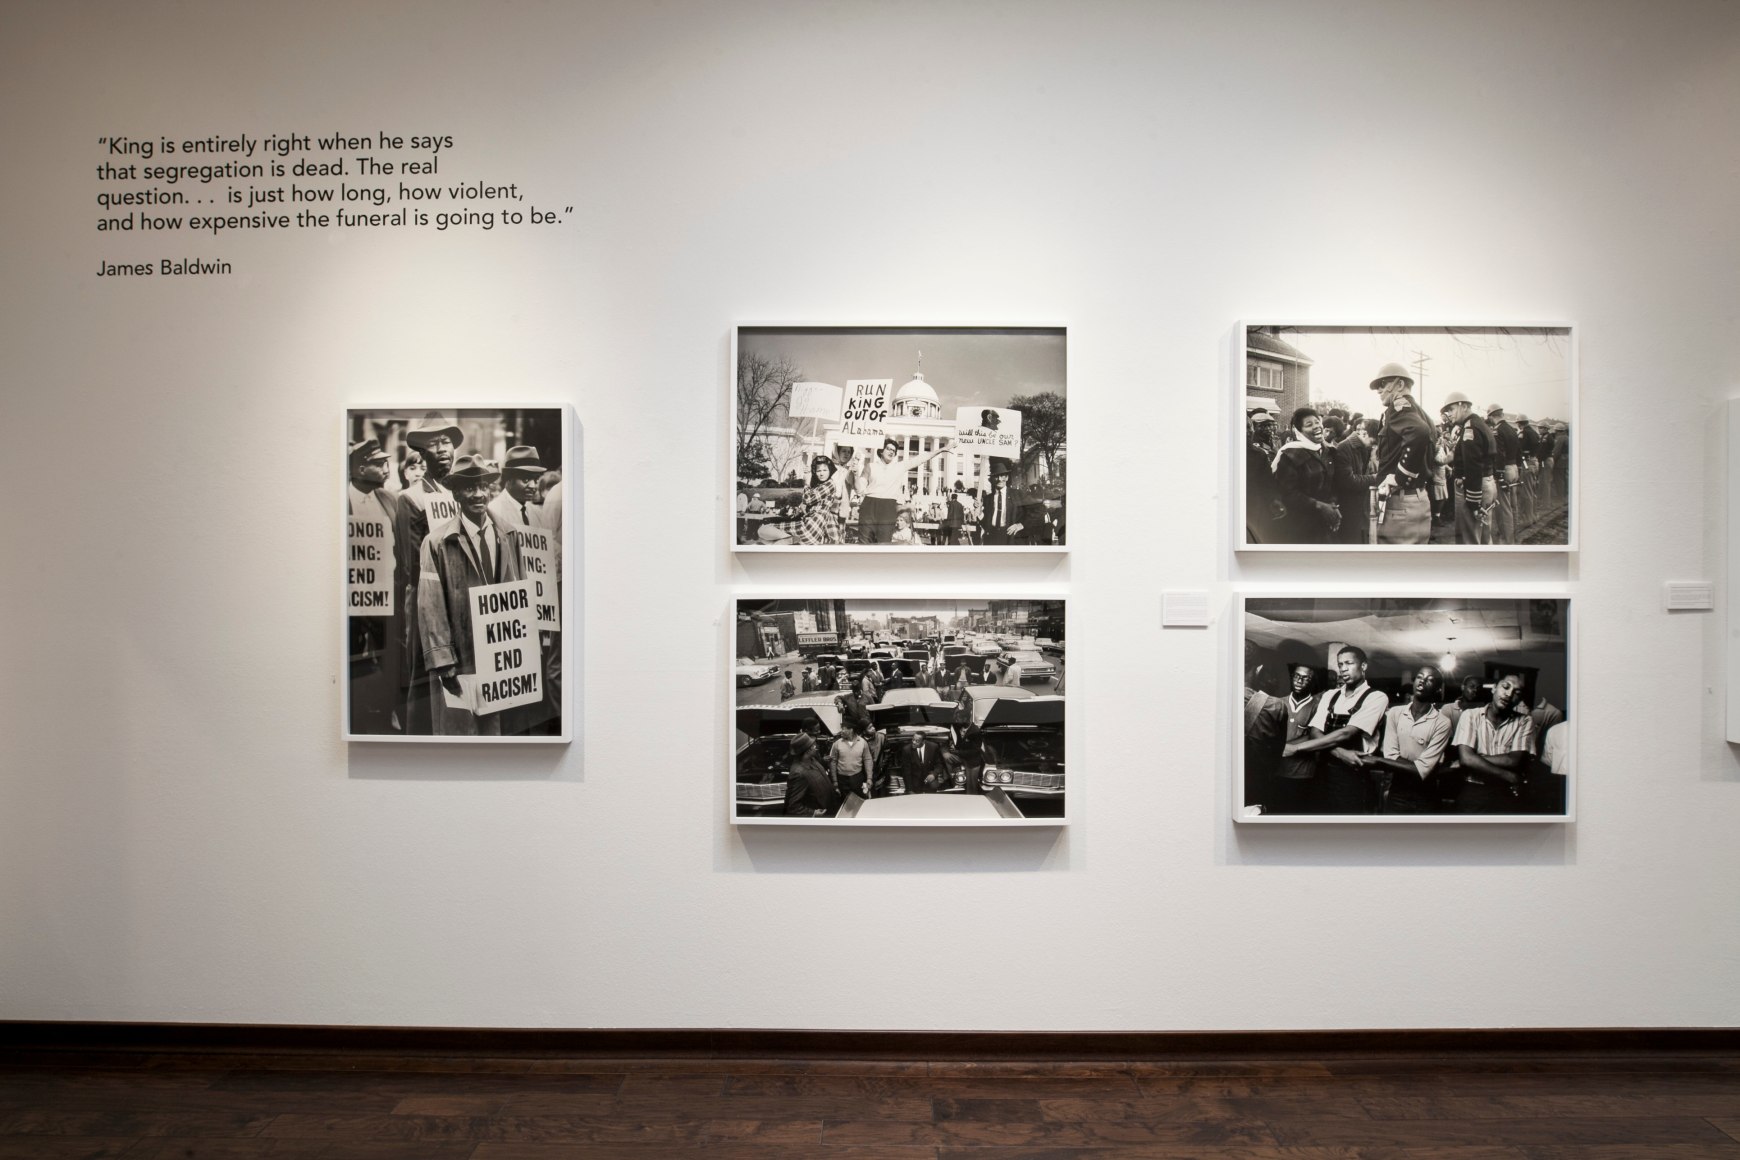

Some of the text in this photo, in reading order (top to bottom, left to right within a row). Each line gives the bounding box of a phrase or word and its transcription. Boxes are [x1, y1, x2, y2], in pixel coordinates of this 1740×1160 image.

[160, 136, 176, 154] is
[181, 133, 257, 158] entirely
[263, 132, 312, 157] right
[317, 131, 372, 151] when
[379, 130, 404, 150] he
[410, 135, 454, 154] says
[96, 155, 438, 185] that segregation is dead. The real
[228, 185, 243, 204] is
[247, 185, 285, 209] just
[291, 183, 335, 203] how
[341, 182, 391, 207] long,
[399, 181, 442, 201] how
[448, 180, 524, 202] violent,
[96, 211, 134, 232] and
[140, 211, 183, 231] how
[188, 210, 291, 236] expensive
[296, 208, 330, 228] the
[335, 207, 407, 227] funeral
[414, 208, 429, 226] is
[435, 207, 495, 231] going
[500, 209, 523, 225] to
[96, 257, 232, 277] James Baldwin
[856, 384, 887, 396] RUN
[348, 544, 381, 561] ING:
[348, 567, 375, 585] END
[348, 590, 389, 607] CISM!
[478, 588, 529, 616] HONOR
[486, 618, 527, 644] KING:
[494, 648, 523, 673] END
[481, 672, 538, 703] RACISM!
